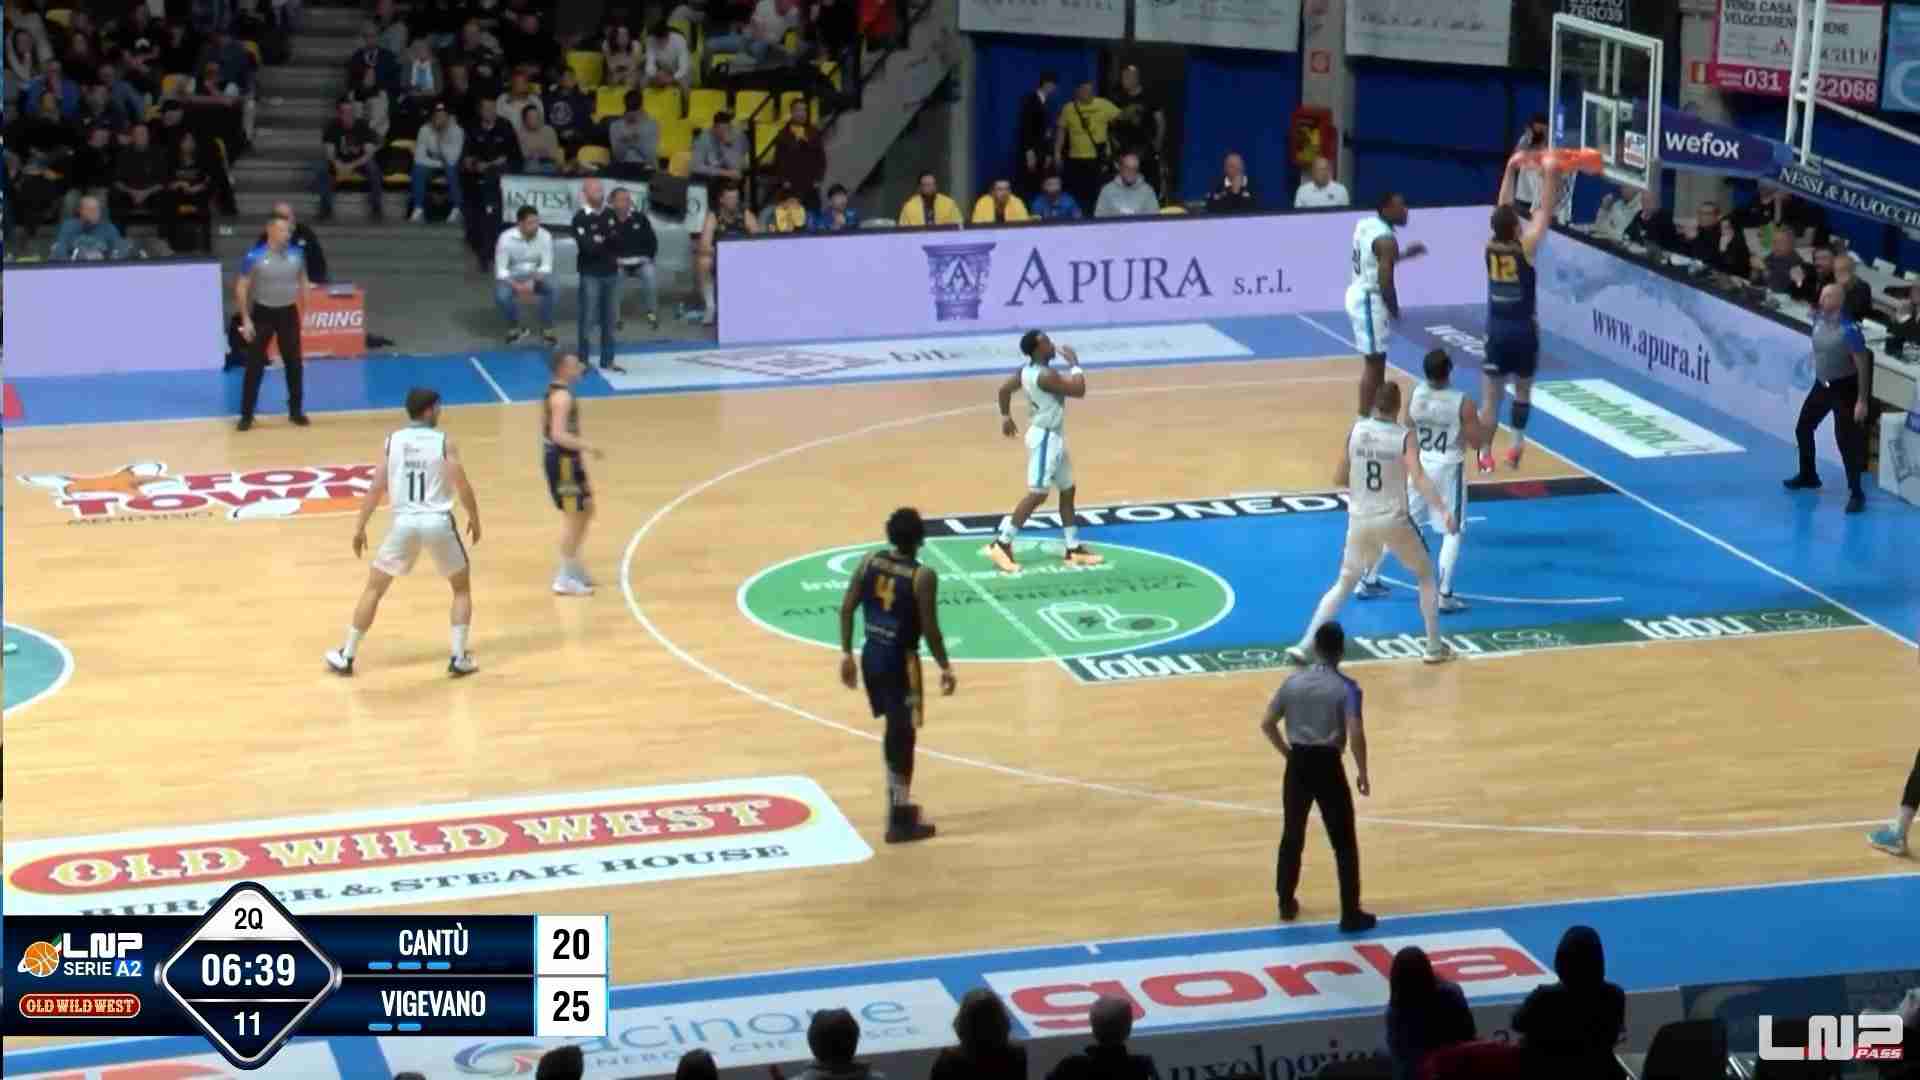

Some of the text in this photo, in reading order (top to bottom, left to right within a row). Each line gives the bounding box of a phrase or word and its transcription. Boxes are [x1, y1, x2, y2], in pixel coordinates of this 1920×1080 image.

[1744, 68, 1782, 91] 031
[1815, 79, 1878, 102] 22068
[1665, 131, 1740, 159] wefox
[1824, 185, 1839, 200] &
[1004, 246, 1292, 306] APURA s.r.l.
[1489, 255, 1519, 282] 12
[311, 310, 364, 329] RING
[1592, 307, 1712, 385] www.apura.it
[1420, 427, 1448, 455] 24
[182, 466, 377, 491] FOX
[406, 471, 426, 502] 11
[1366, 461, 1382, 492] 8
[873, 574, 896, 609] 4
[1624, 615, 1756, 640] tabu
[1077, 654, 1206, 681] tabu
[49, 799, 772, 887] OLD WILD WEST
[390, 862, 583, 893] STEAK
[600, 845, 790, 873] HOUSE
[1010, 943, 1544, 1031] gorla
